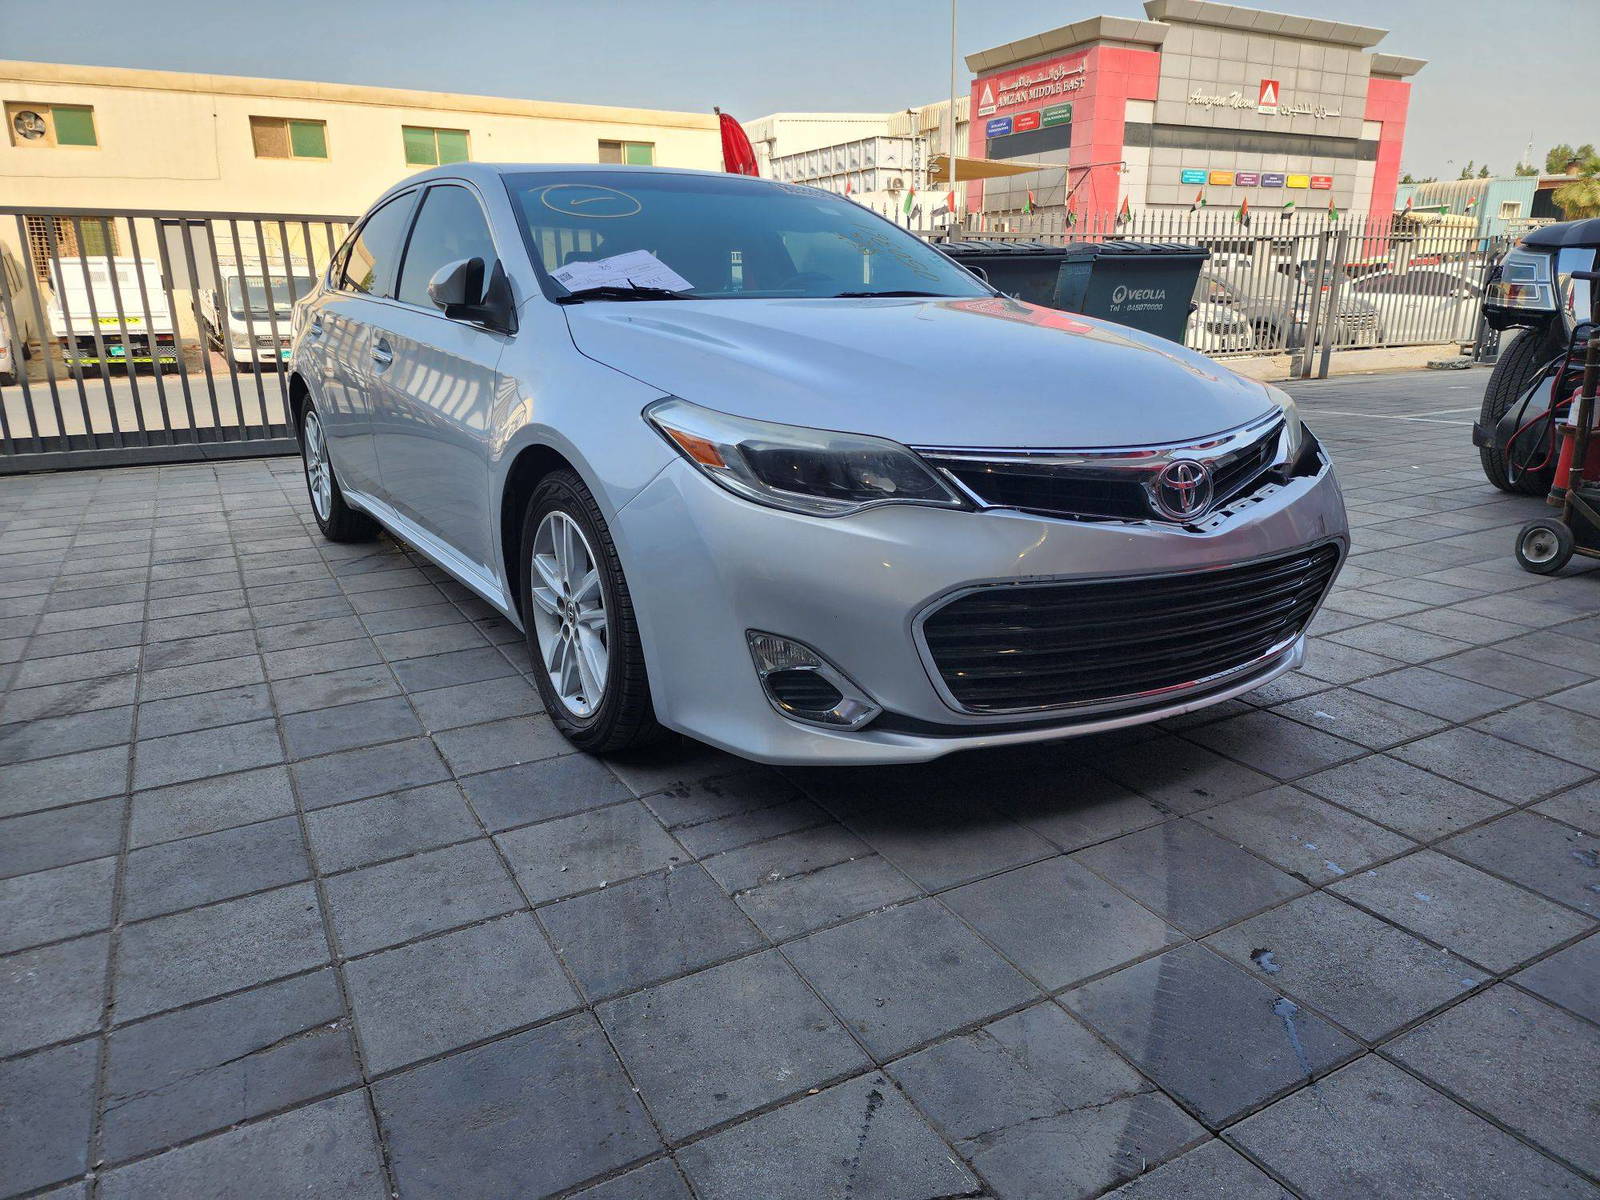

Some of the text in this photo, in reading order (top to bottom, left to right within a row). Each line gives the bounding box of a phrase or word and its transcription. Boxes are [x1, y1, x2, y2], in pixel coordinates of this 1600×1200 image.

[997, 76, 1087, 108] AMZAN MIDDLE EAST
[1188, 88, 1227, 111] Amzan
[1128, 289, 1166, 300] VEOLIA
[1110, 304, 1121, 312] Tel
